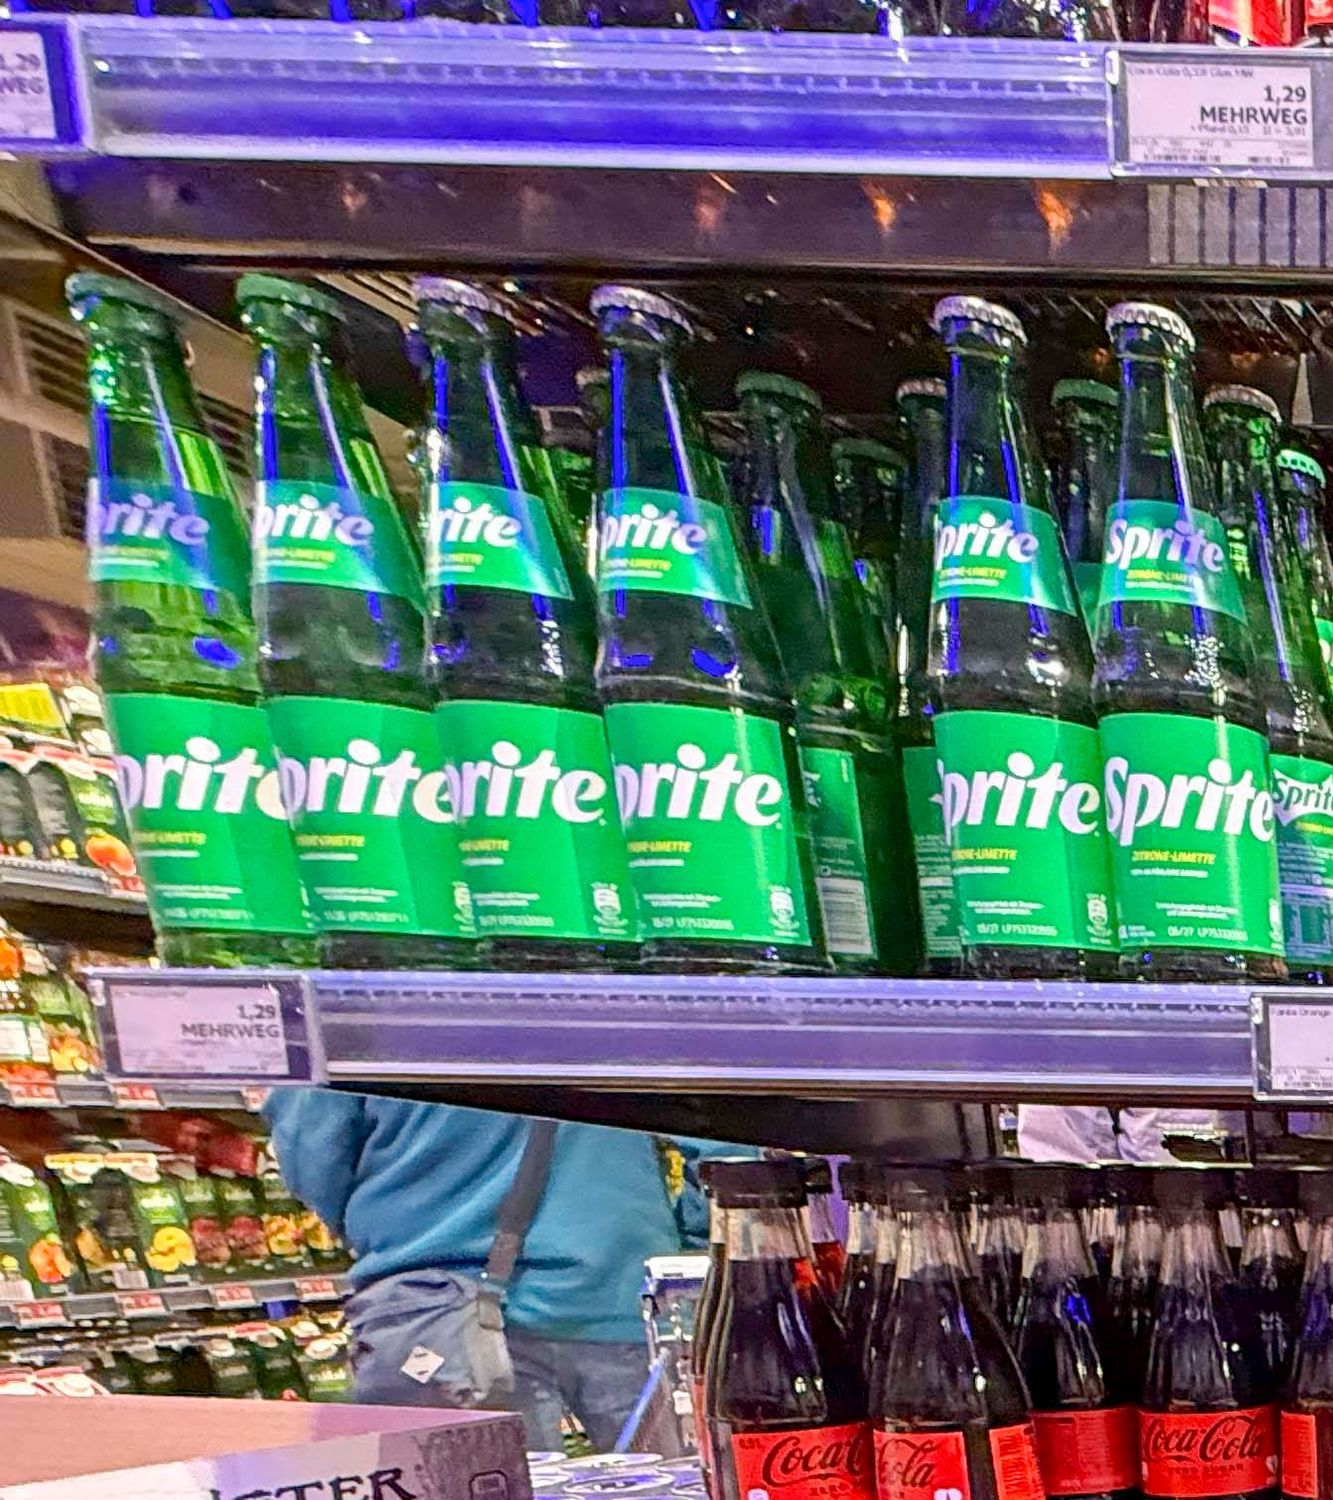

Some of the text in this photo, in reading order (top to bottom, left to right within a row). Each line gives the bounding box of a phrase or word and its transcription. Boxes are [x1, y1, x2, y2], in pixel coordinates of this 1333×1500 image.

[1263, 85, 1307, 104] 1,29
[1199, 105, 1308, 125] MEHRWEG
[430, 496, 523, 548] rite
[1104, 517, 1226, 574] Sprite
[1103, 756, 1275, 847] Sprite
[236, 1003, 276, 1020] 1,29
[181, 1022, 281, 1039] MEHRWEG
